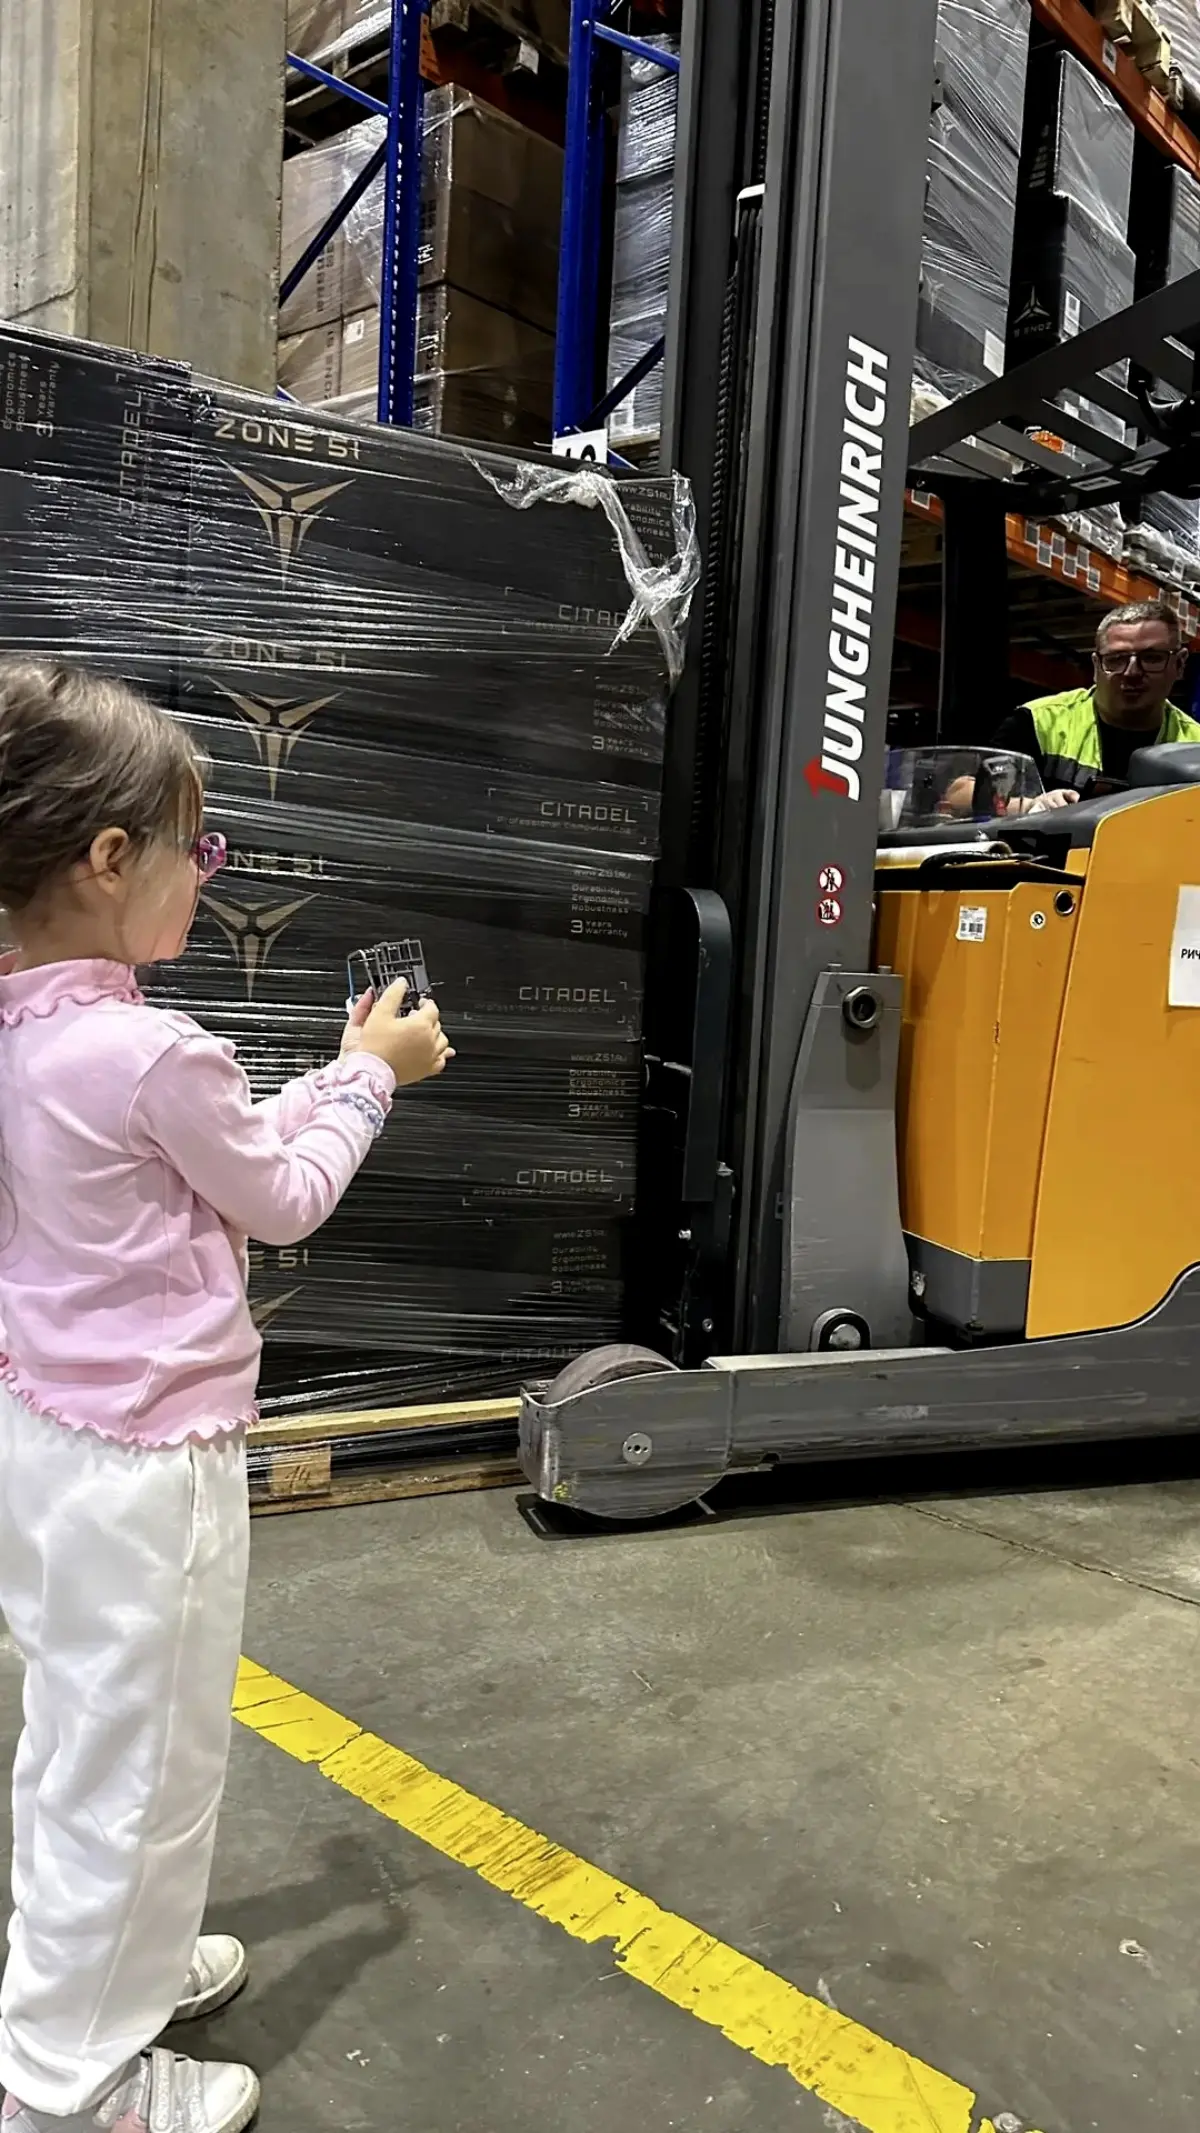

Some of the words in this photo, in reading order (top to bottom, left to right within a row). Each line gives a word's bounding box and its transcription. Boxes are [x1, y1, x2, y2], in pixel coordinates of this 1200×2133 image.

[214, 418, 315, 452] ZONE
[328, 436, 360, 460] 51
[821, 335, 889, 801] JUNGHEINRICH
[591, 736, 604, 750] 3
[541, 802, 638, 823] CITADEL
[571, 919, 584, 934] 3
[585, 920, 612, 928] Years
[585, 928, 629, 938] Warranty
[519, 986, 616, 1003] CITADEL
[568, 1104, 581, 1117] 3
[516, 1169, 614, 1185] CITADEL
[278, 1248, 309, 1269] 51
